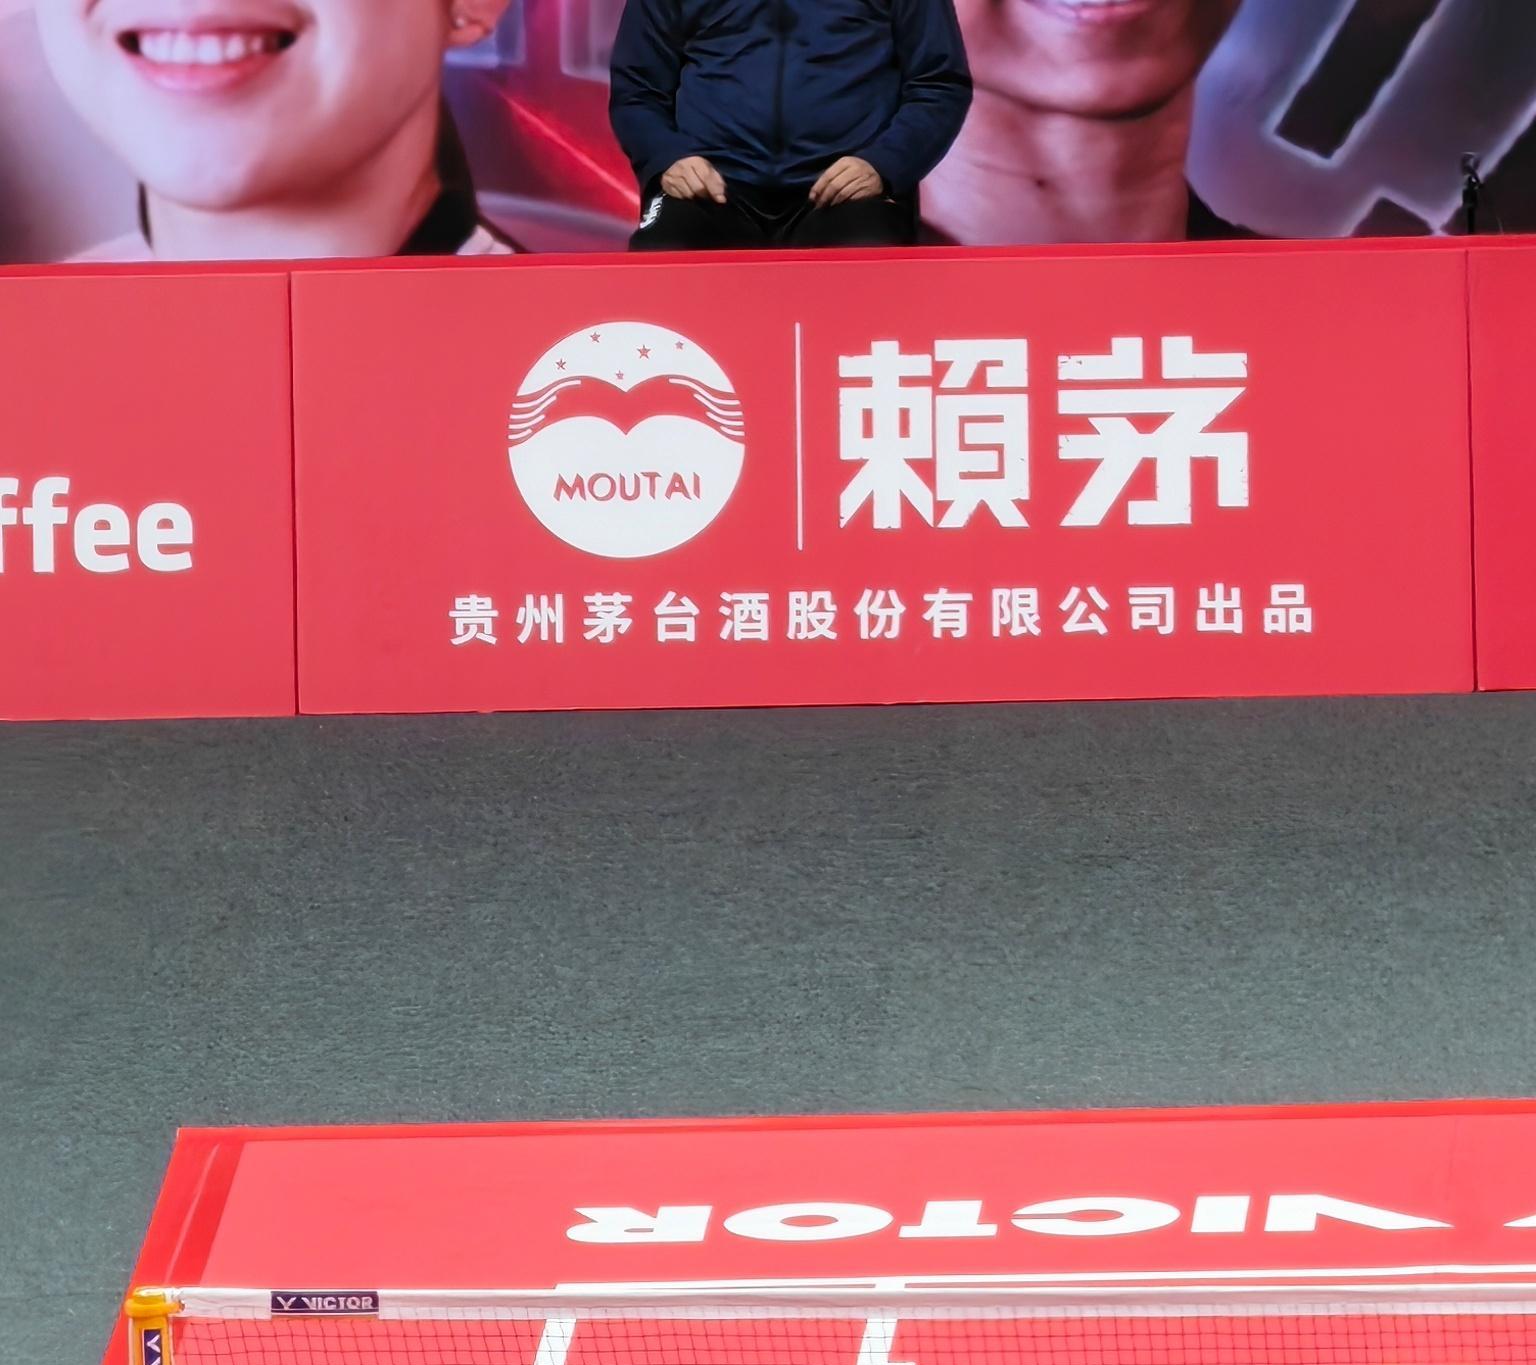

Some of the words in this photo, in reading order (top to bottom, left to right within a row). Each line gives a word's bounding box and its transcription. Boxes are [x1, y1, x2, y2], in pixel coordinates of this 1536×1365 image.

[555, 472, 700, 502] MOUTAI
[448, 582, 1313, 645] 贵州茅台酒股份有限公司出品
[566, 1194, 1454, 1244] VICTOR
[301, 1295, 374, 1311] VICTOR
